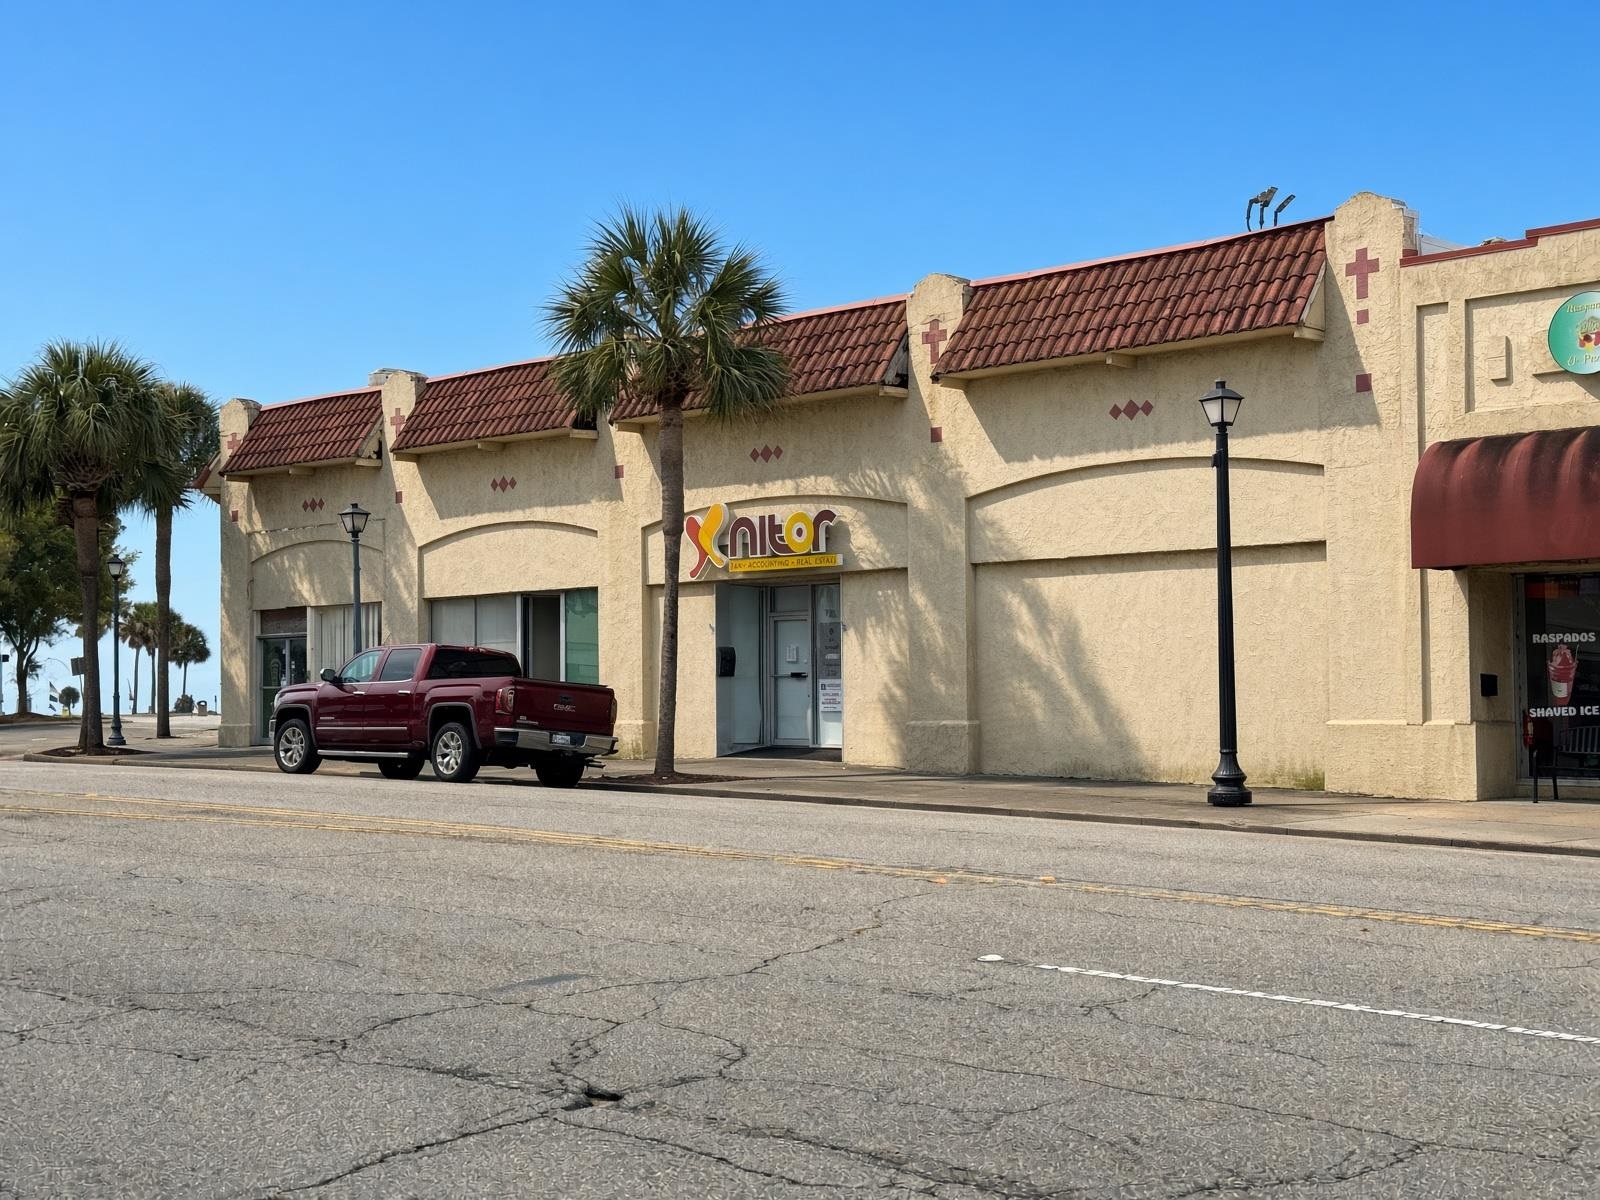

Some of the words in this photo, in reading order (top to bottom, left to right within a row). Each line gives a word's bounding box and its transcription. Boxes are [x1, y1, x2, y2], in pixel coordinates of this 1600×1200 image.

[796, 557, 812, 566] REAL
[1532, 632, 1597, 644] RASPADOS
[1529, 706, 1577, 718] SHAVED
[1580, 705, 1600, 716] ICE
